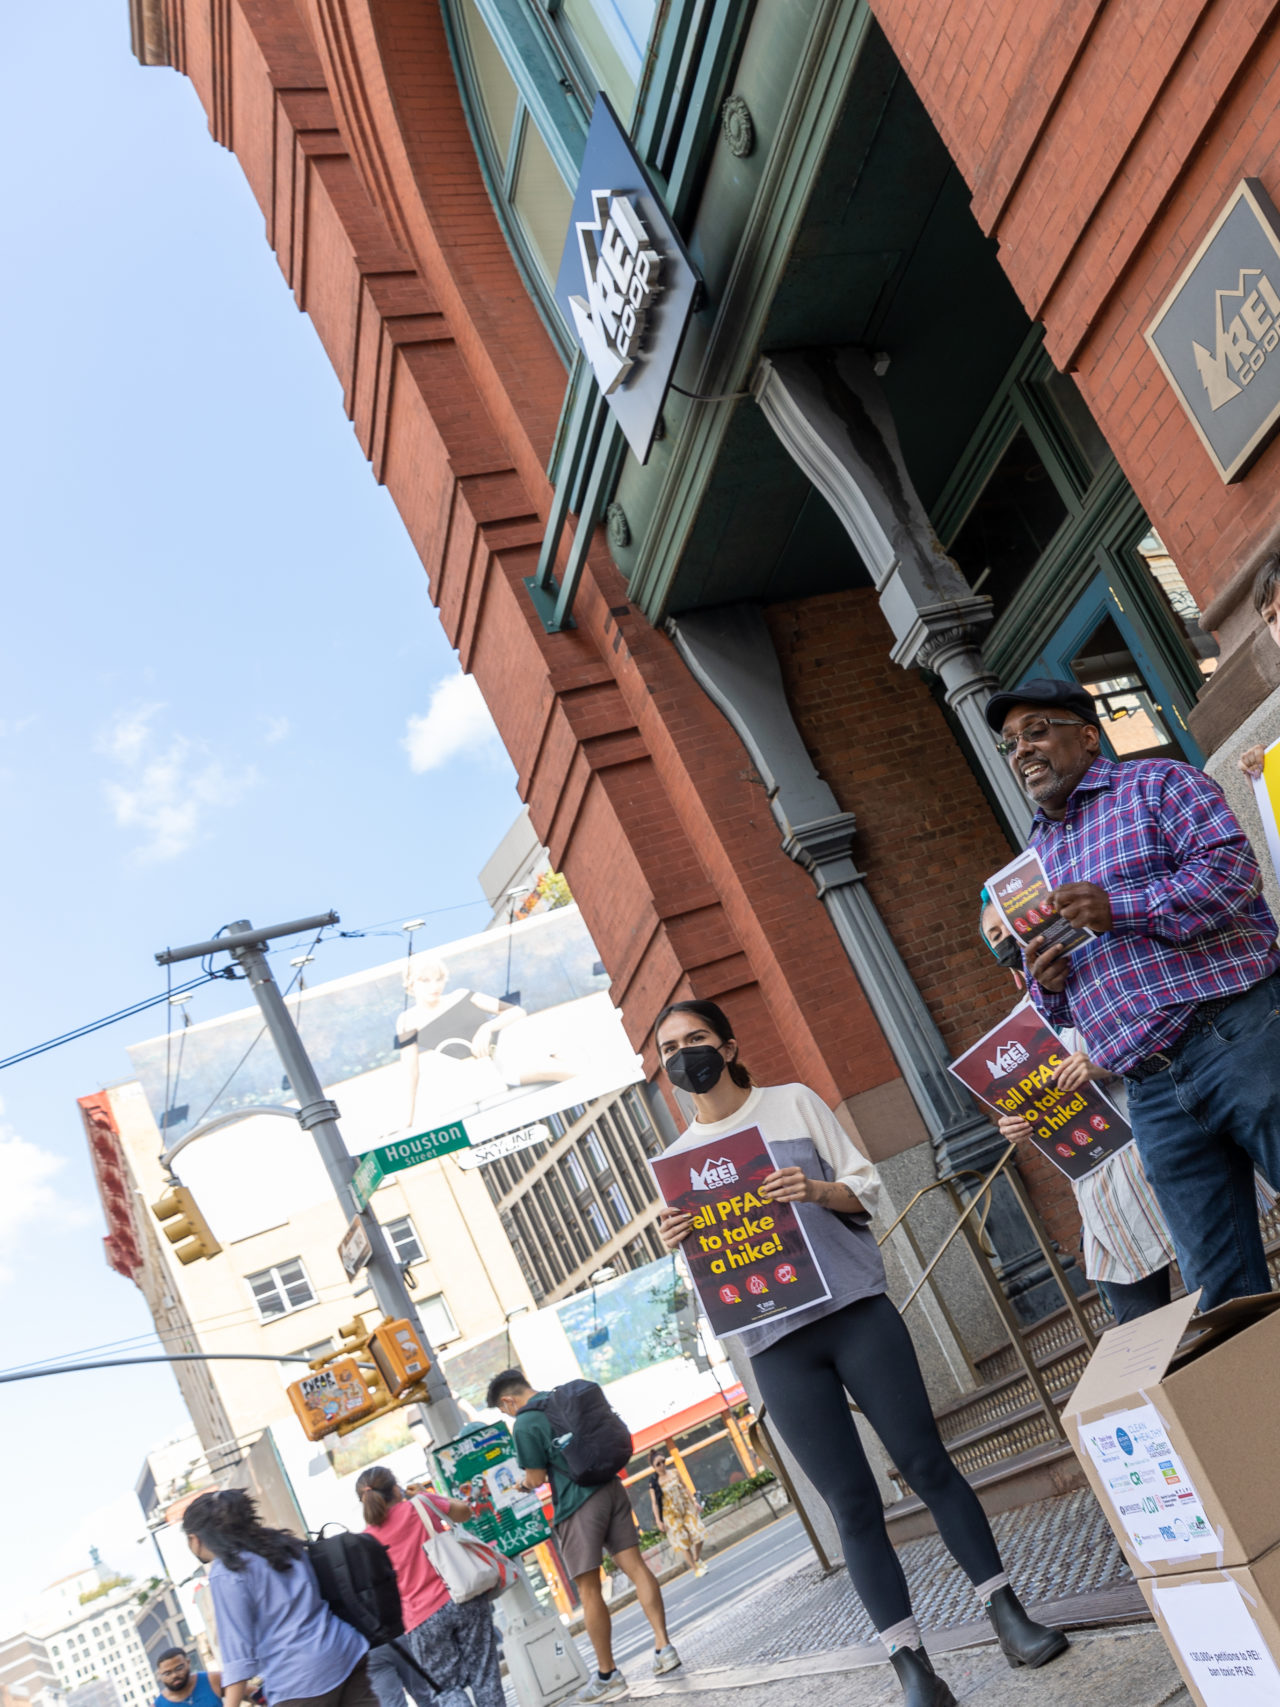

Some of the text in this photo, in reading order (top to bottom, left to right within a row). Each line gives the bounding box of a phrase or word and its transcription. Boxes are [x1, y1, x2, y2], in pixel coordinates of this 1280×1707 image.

[596, 196, 650, 339] REI
[1000, 1042, 1027, 1070] REI
[996, 1086, 1025, 1111] Tell
[1033, 1085, 1069, 1111] tak
[1037, 1092, 1088, 1138] a hike!
[384, 1125, 462, 1162] Houston
[404, 1148, 438, 1166] Street
[706, 1162, 738, 1184] REI
[690, 1205, 717, 1230] ell
[699, 1216, 775, 1252] to take
[710, 1233, 783, 1274] a hike!
[1239, 1651, 1248, 1660] to
